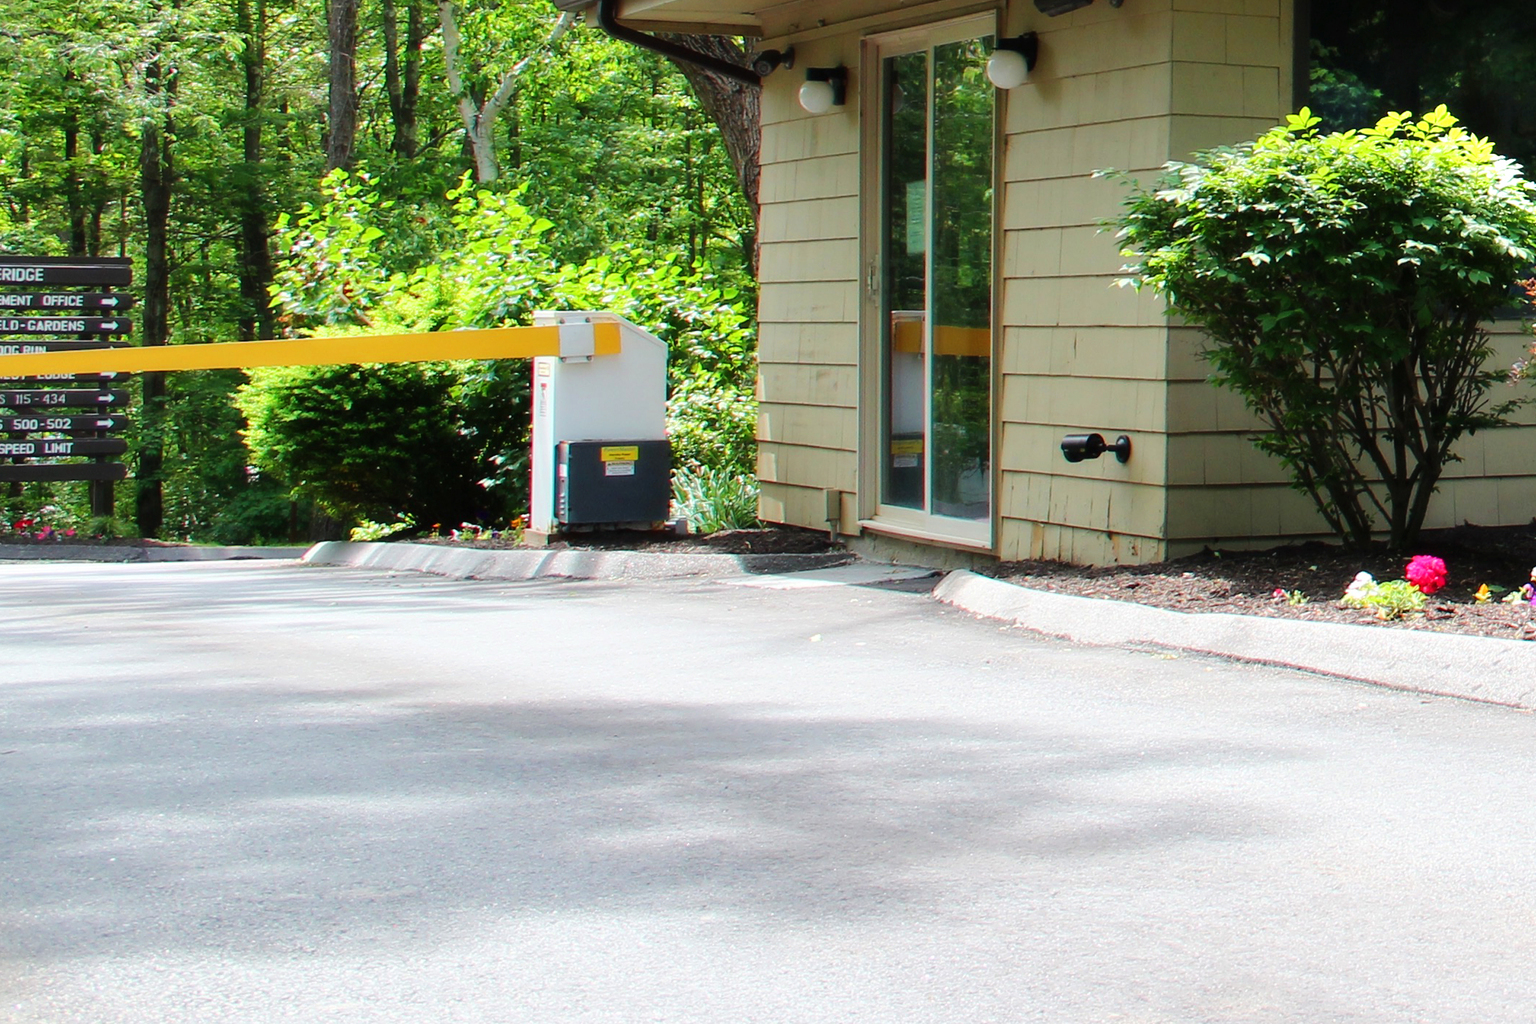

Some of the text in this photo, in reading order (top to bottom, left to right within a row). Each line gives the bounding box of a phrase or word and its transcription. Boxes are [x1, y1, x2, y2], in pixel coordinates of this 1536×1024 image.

[0, 268, 44, 282] RIDGE
[42, 295, 84, 306] OFFICE
[0, 320, 85, 331] LD-GARDENS
[13, 418, 72, 430] 500-502
[0, 442, 74, 455] SPEED LIMIT
